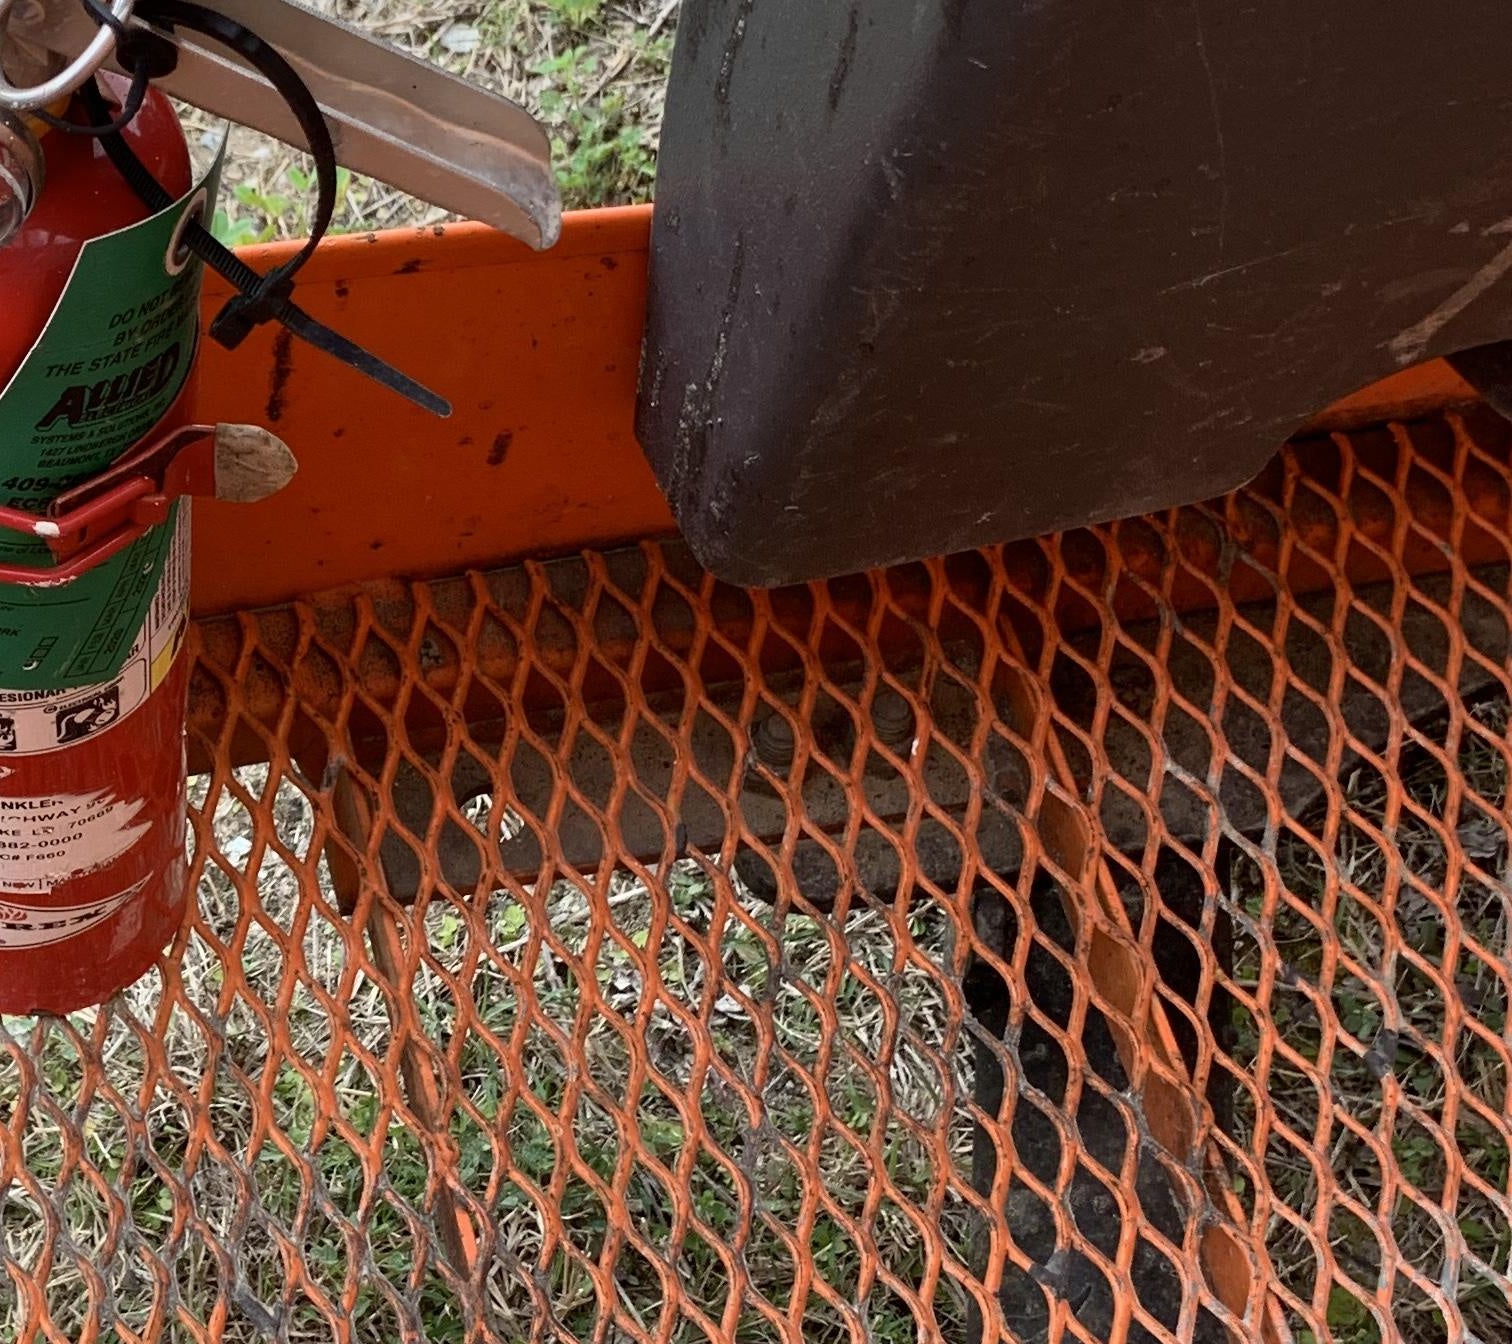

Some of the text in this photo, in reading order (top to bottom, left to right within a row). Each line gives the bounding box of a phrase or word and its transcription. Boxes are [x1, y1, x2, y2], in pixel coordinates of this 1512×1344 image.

[108, 308, 135, 329] DO
[113, 328, 139, 347] BY
[44, 361, 85, 377] THE
[88, 342, 143, 372] STATE
[34, 341, 181, 433] ALLIED
[30, 431, 86, 445] SYSTEMS
[2, 880, 35, 888] NW
